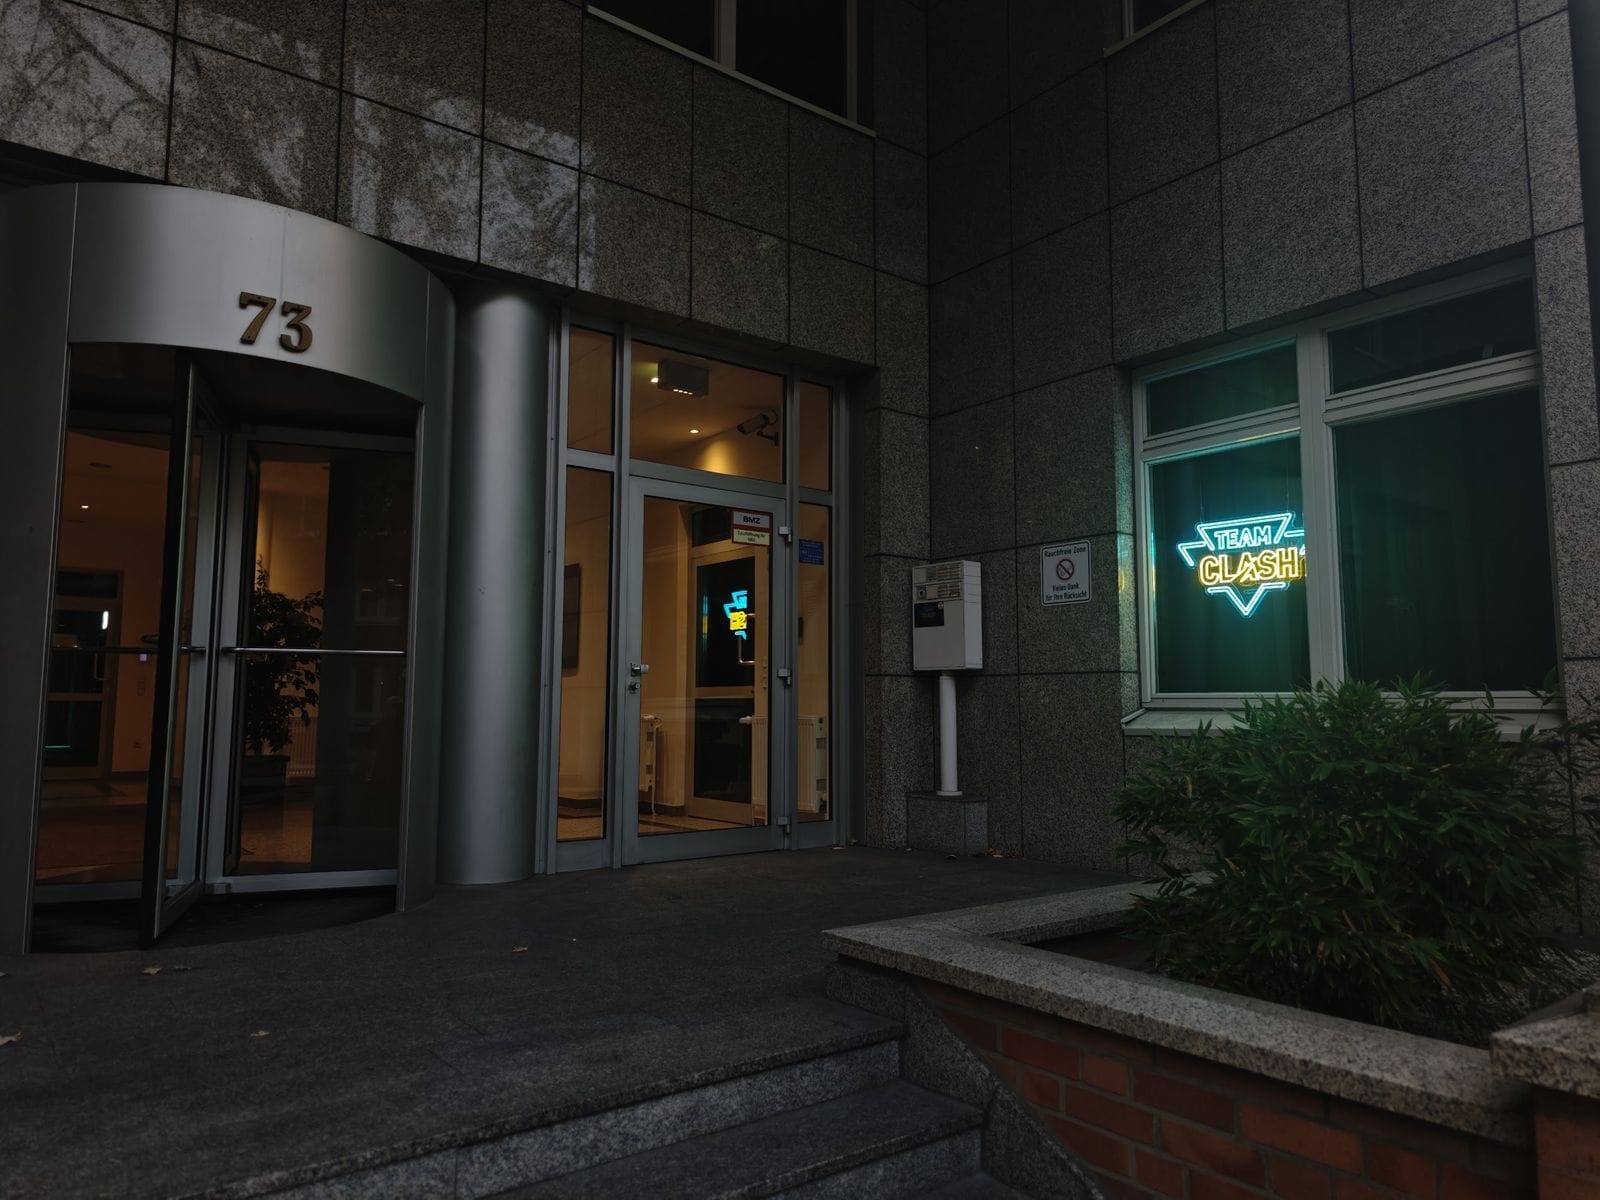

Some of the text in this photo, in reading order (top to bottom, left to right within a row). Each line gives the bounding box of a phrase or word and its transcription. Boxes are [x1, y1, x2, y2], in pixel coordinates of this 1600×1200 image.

[239, 291, 313, 353] 73
[743, 516, 760, 524] BMZ
[1214, 525, 1272, 550] TEAM
[1045, 548, 1071, 557] Rauchfreie
[1199, 547, 1299, 586] CLASH
[1068, 582, 1079, 590] Dank
[1064, 590, 1087, 599] Rücksicht
